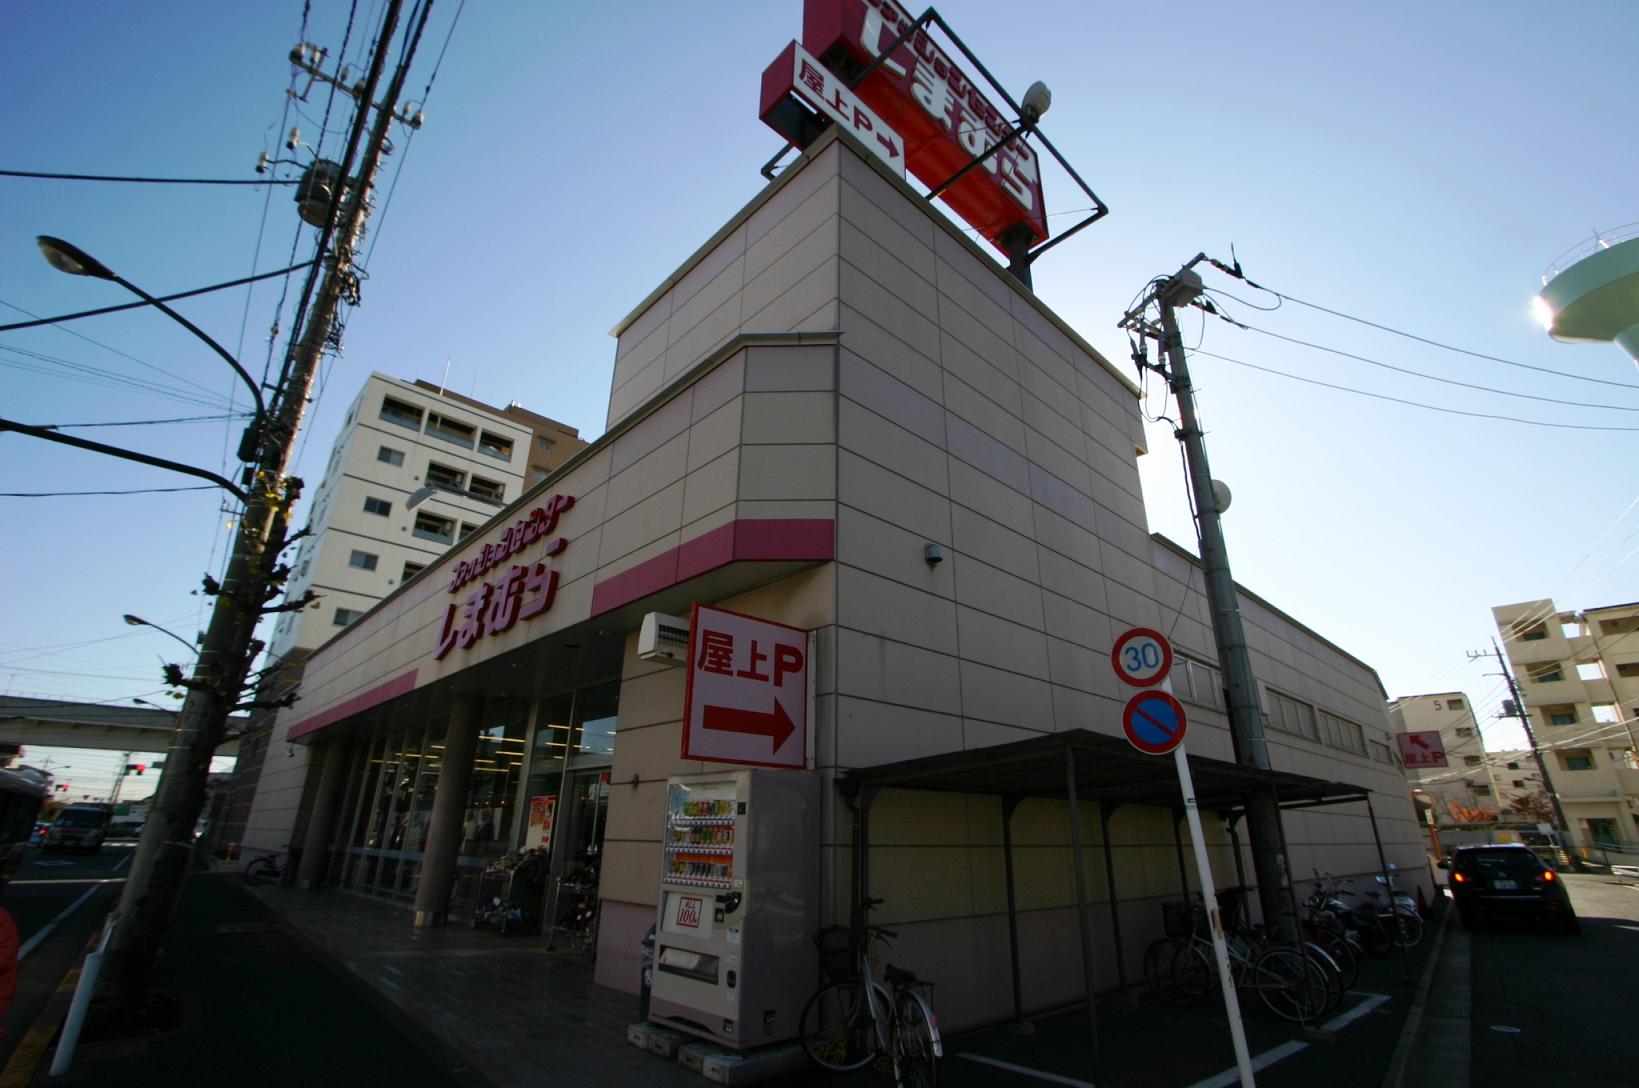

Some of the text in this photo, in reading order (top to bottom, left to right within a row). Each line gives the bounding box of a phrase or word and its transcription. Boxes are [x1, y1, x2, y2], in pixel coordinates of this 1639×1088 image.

[801, 58, 873, 135] 屋上P
[861, 5, 1037, 212] しまむら
[434, 537, 568, 660] しまむら
[697, 629, 804, 687] 屋上P
[1125, 642, 1160, 672] 30
[1433, 700, 1442, 711] 5
